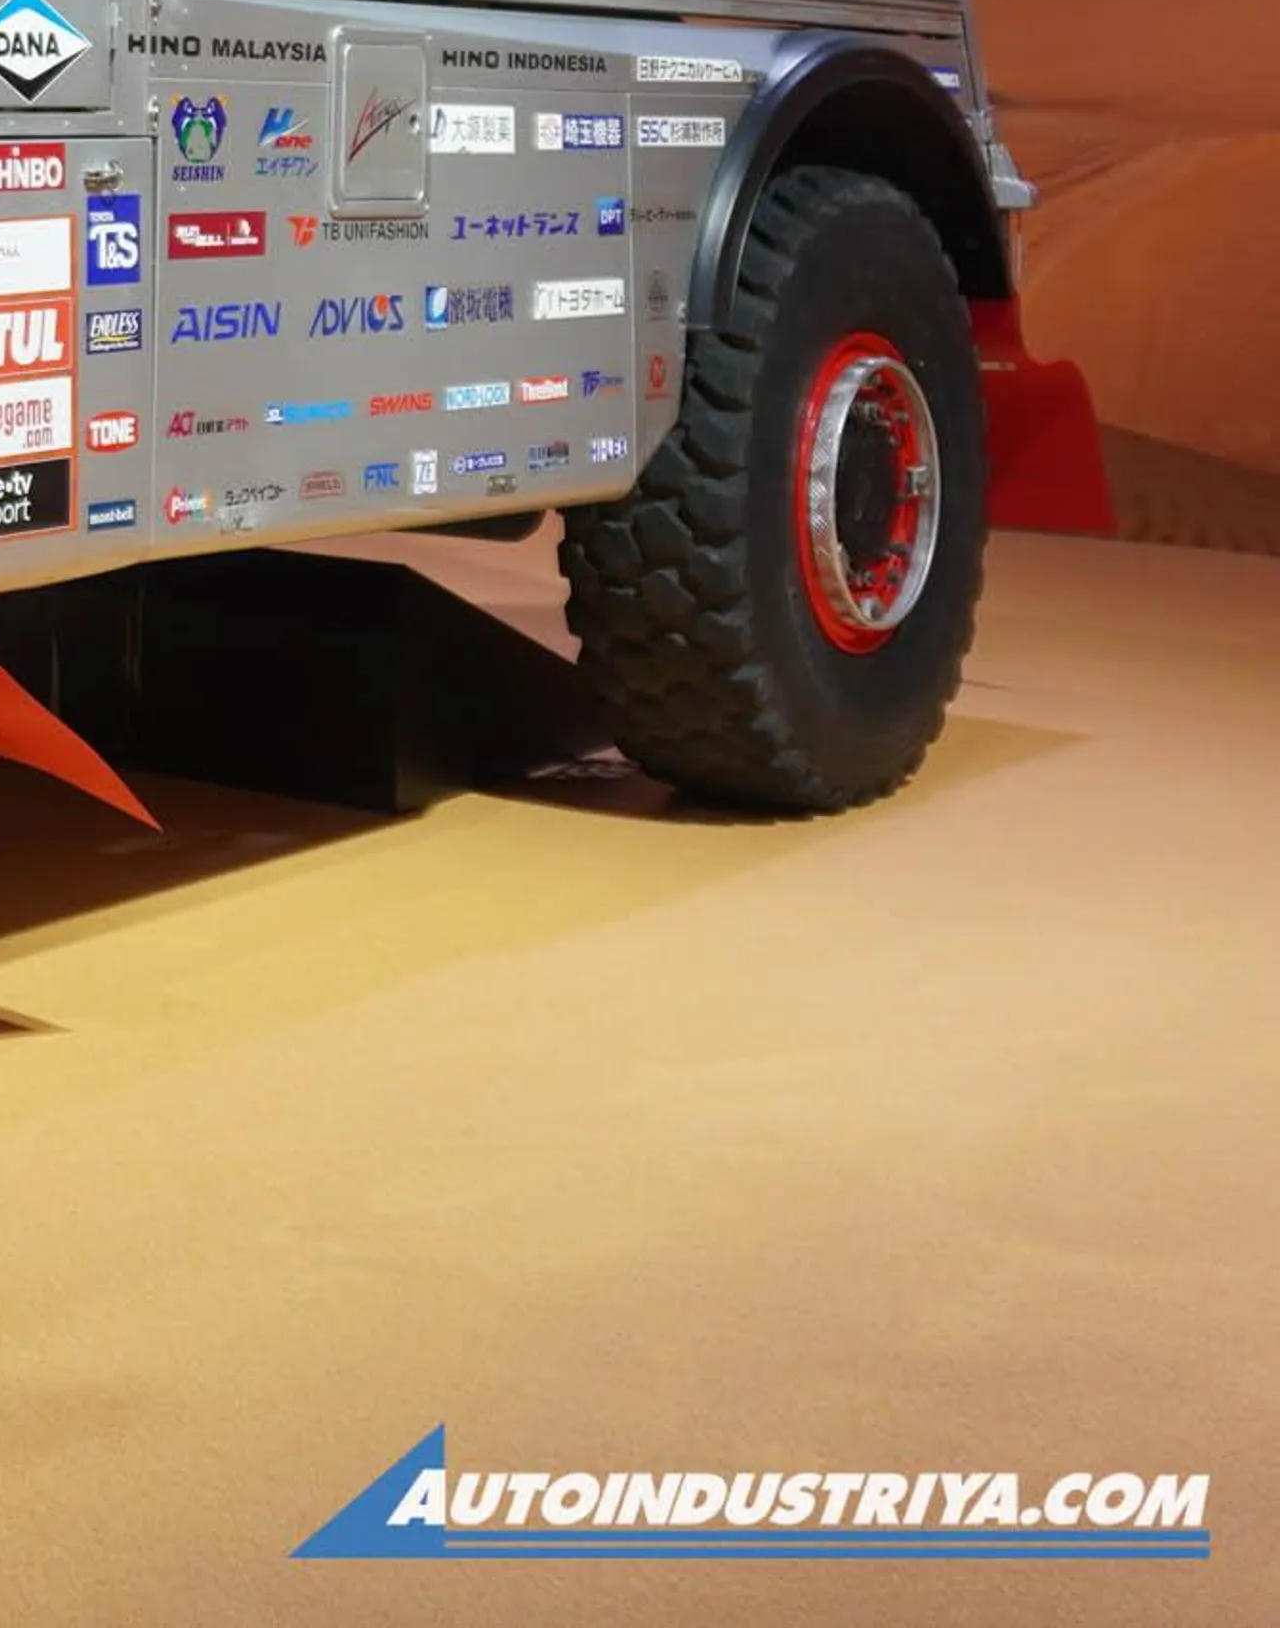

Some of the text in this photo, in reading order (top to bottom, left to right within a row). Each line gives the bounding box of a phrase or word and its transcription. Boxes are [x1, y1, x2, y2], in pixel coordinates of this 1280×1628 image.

[127, 33, 328, 63] HINO MALAYSIA
[442, 49, 608, 74] HINO INDONESIA
[171, 164, 226, 182] SEISHIN
[600, 208, 624, 226] DPT
[321, 221, 430, 242] TB UNIFASHION
[88, 222, 139, 271] T&S
[90, 311, 139, 338] ENDLESS
[170, 301, 282, 344] AISIN
[308, 294, 405, 339] ADVICS
[20, 424, 54, 449] .com
[89, 416, 137, 448] TONE
